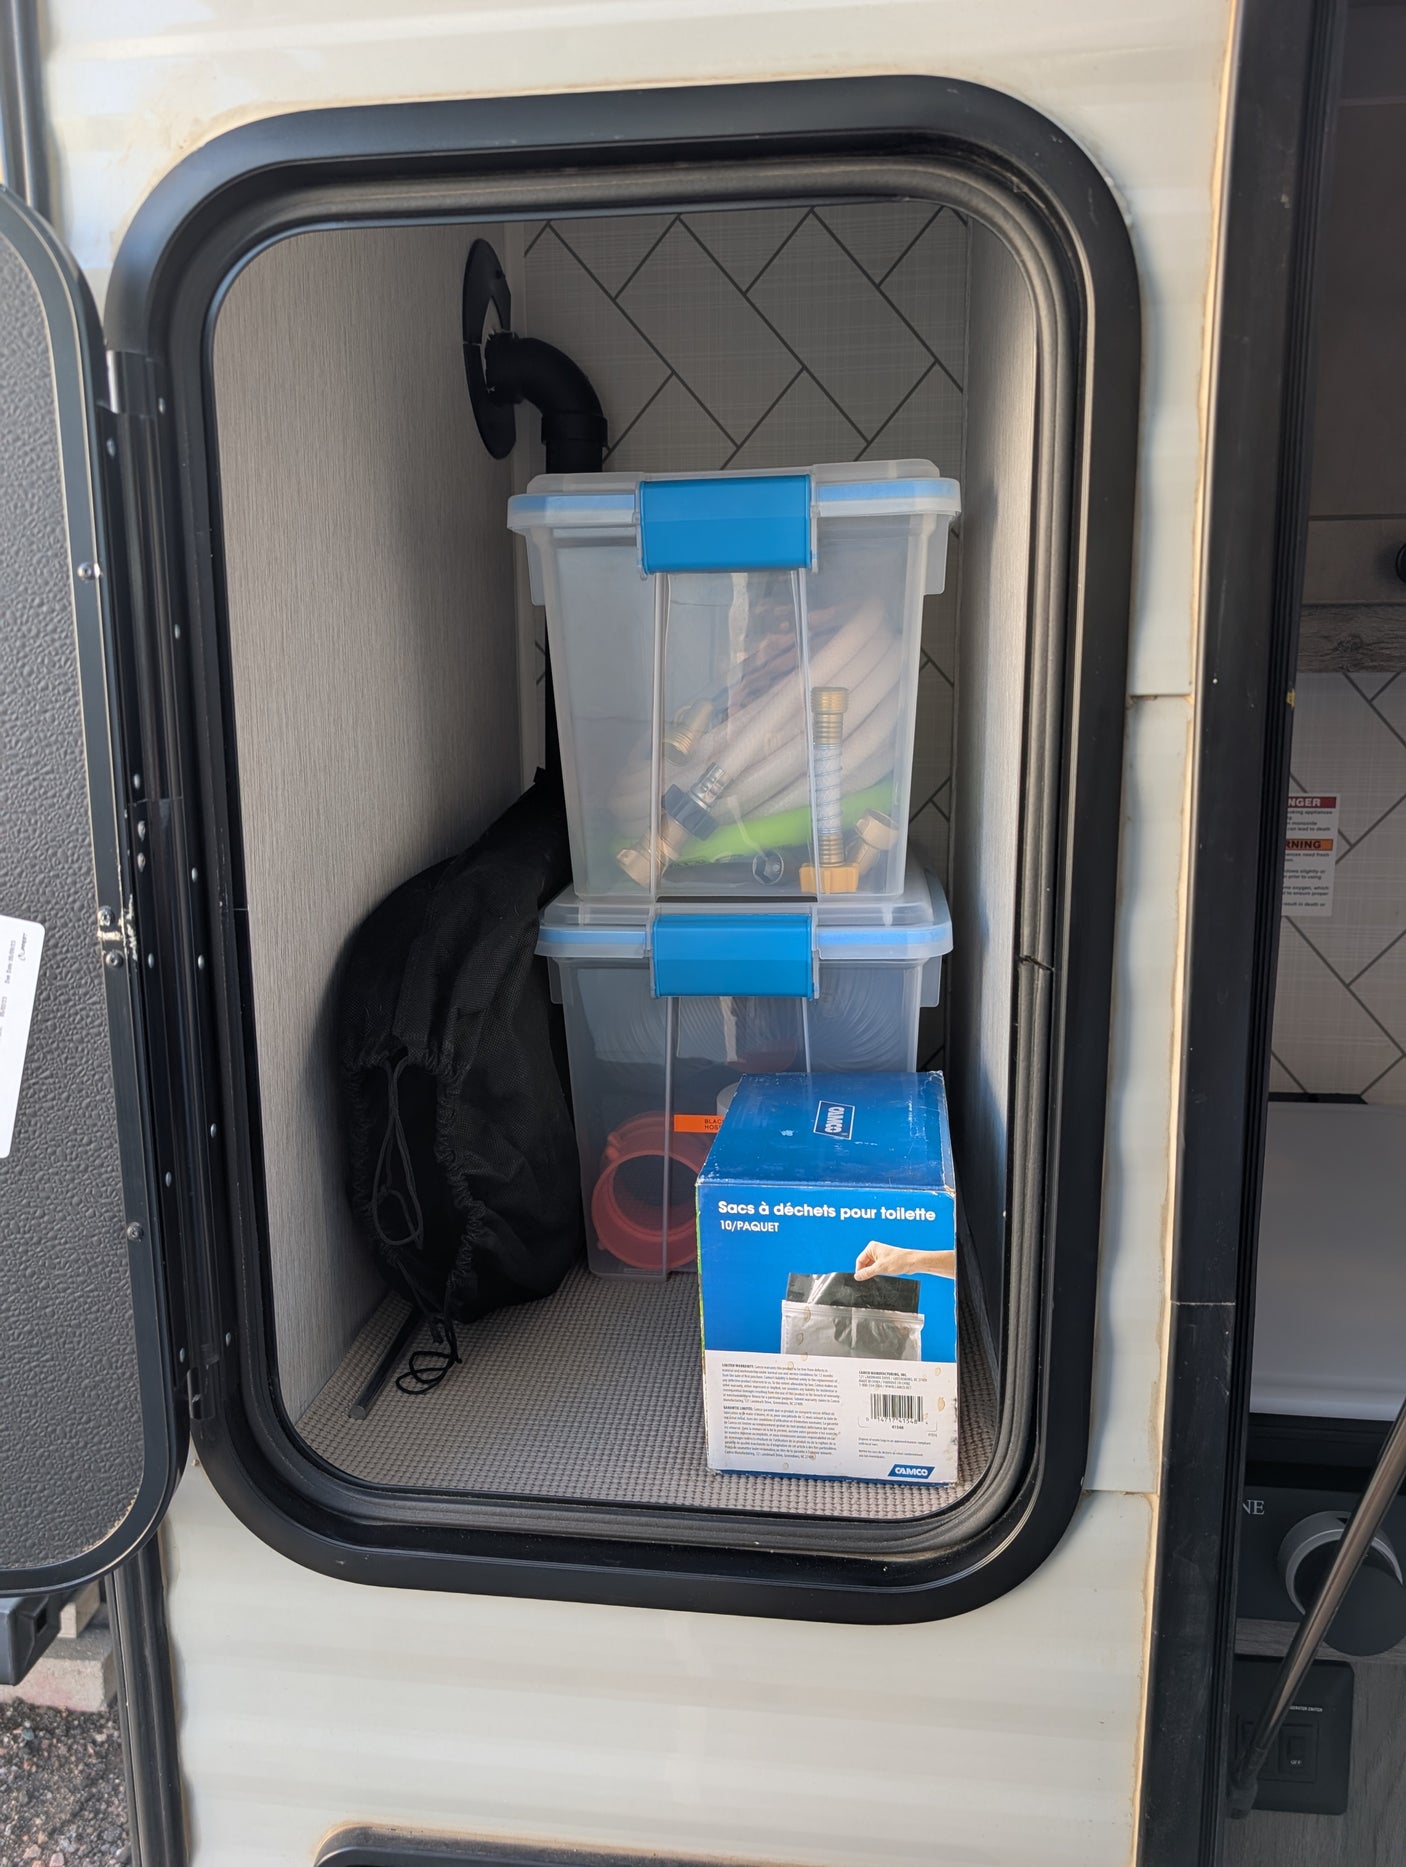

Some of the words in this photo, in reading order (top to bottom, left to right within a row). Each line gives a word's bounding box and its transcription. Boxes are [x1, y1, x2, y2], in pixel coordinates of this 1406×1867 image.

[824, 1105, 846, 1133] CAMCO
[717, 1200, 755, 1215] Sacs
[758, 1200, 770, 1215] à
[773, 1201, 837, 1218] déchets
[840, 1207, 877, 1220] pour
[880, 1206, 936, 1222] toilette
[719, 1219, 780, 1233] 10/PAQUET
[894, 1467, 929, 1476] CAMCO
